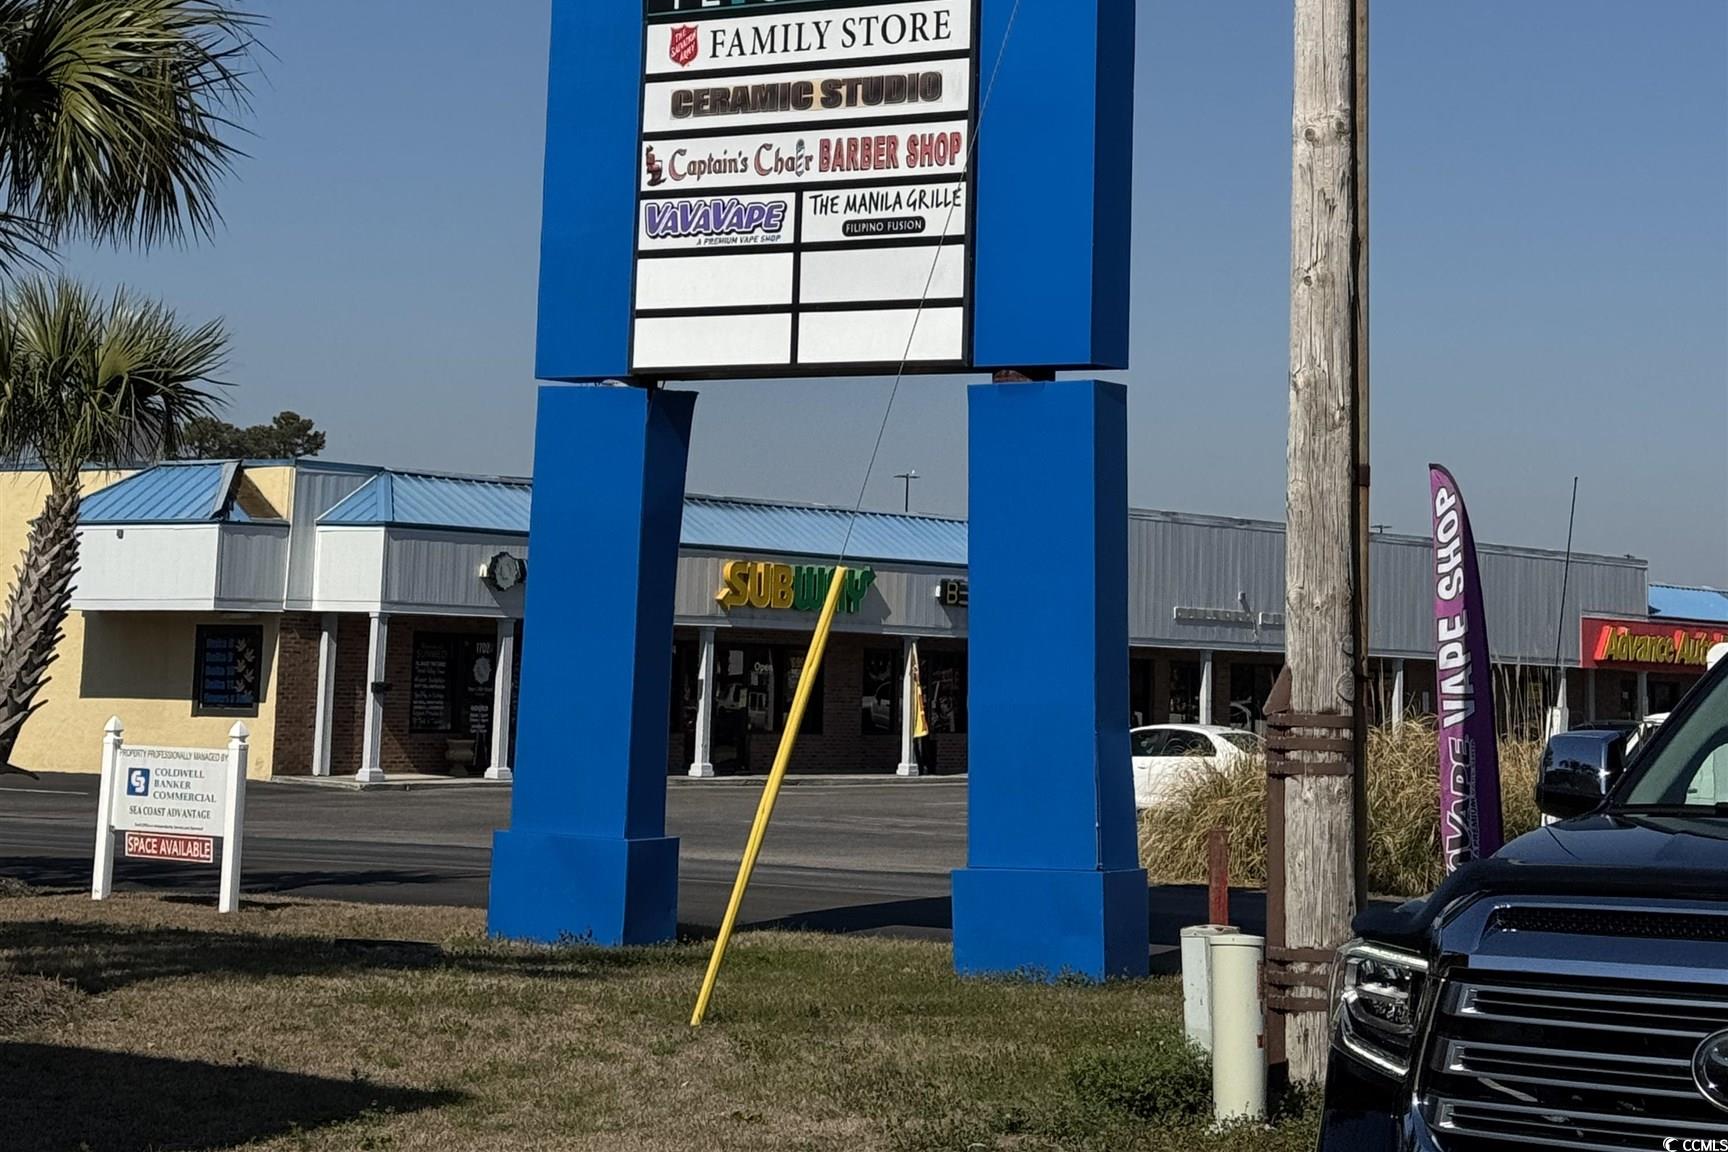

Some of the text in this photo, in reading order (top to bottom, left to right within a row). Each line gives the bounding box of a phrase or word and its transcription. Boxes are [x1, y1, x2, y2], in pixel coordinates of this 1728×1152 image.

[709, 9, 952, 59] FAMILY STORE
[670, 70, 943, 120] CERAMIC STUDIO
[668, 148, 749, 182] Captain's
[817, 134, 900, 173] BARBER
[905, 131, 963, 169] SHOP
[808, 187, 963, 216] THE MANILA GRILLE
[846, 218, 923, 234] FILIPINO FUSION
[703, 235, 738, 245] PREMIUM
[740, 233, 759, 243] VAPE
[761, 231, 781, 242] SHOP
[1436, 486, 1475, 729] VAPE SHOP
[1596, 625, 1675, 663] Advance
[153, 779, 192, 790] BANKER
[155, 768, 205, 779] COLDWELL
[153, 791, 216, 803] COMMERCIAL
[128, 805, 211, 819] SEA COAST ADVANTAGE
[128, 836, 210, 858] SPACE AVAILABLE
